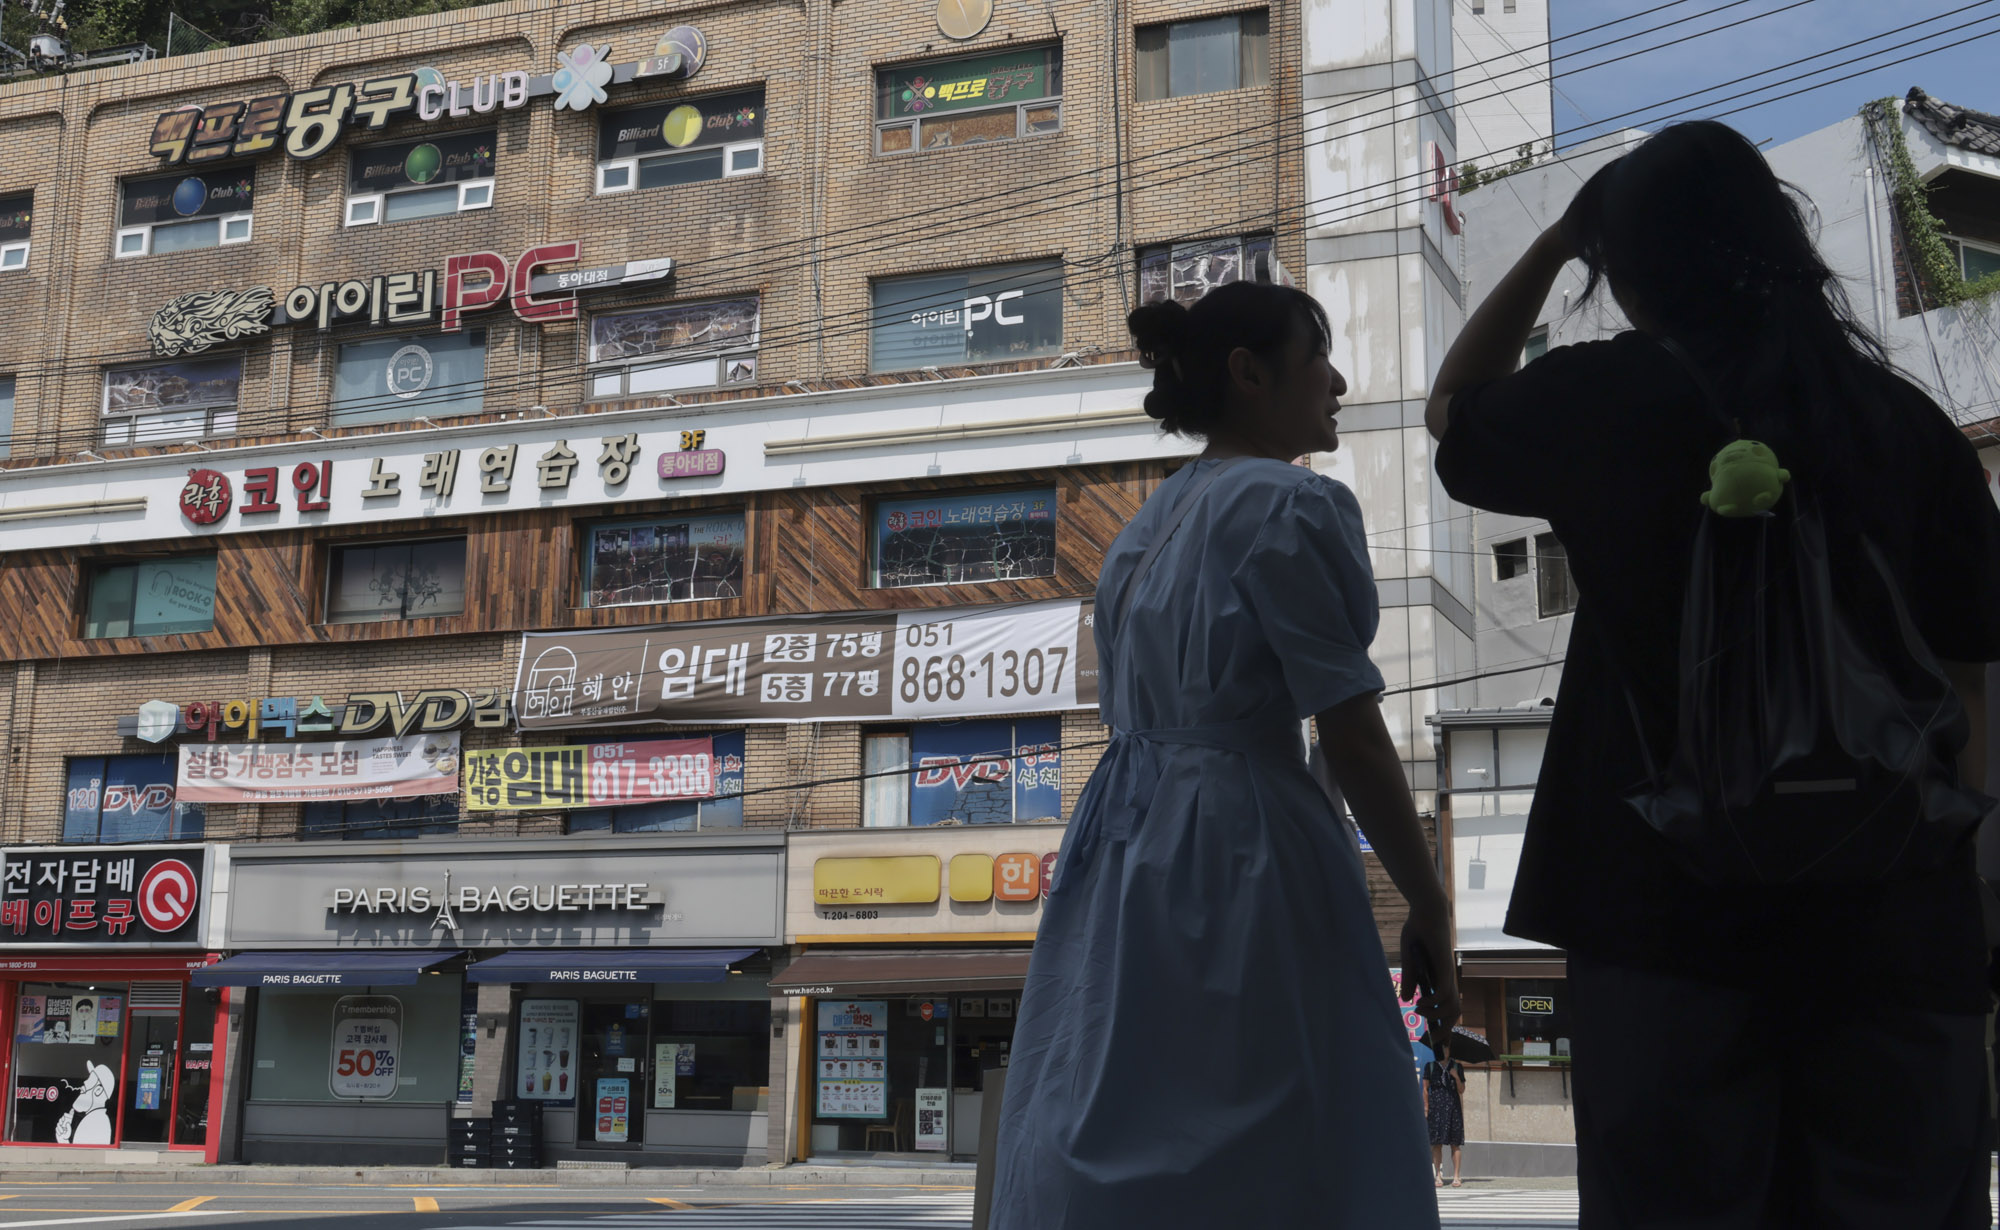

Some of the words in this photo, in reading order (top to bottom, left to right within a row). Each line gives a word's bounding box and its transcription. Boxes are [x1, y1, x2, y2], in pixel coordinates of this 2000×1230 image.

[618, 125, 659, 142] Billiard
[707, 114, 734, 129] Club
[363, 161, 402, 178] Billiard
[446, 151, 471, 165] Club
[210, 186, 234, 199] Club
[284, 268, 437, 332] 아이린
[441, 240, 582, 333] PC
[558, 269, 609, 288] 동아대점
[911, 309, 961, 328] 아이린
[964, 290, 1024, 331] PC
[397, 366, 422, 384] PC
[679, 430, 706, 450] 3F
[238, 459, 332, 514] 코인
[361, 432, 640, 499] 노래연습장
[660, 450, 720, 477] 동아대점
[909, 509, 943, 528] 코인
[944, 501, 1027, 525] 노래연습장
[1033, 501, 1046, 511] 3F
[770, 635, 810, 661] 2층
[826, 631, 883, 658] 75평
[906, 622, 953, 648] 051
[658, 641, 750, 700] 임대
[766, 675, 807, 702] 5층
[823, 669, 879, 697] 77평
[184, 695, 334, 741] 아이맥스
[372, 745, 404, 753] HAPPINESS
[393, 751, 411, 759] SWEET
[1018, 744, 1060, 767] 영화
[186, 751, 229, 779] 설빙
[236, 751, 314, 779] 가맹점주
[319, 750, 359, 776] 모집
[503, 749, 584, 806] 임대
[591, 752, 711, 802] 817-3388
[915, 754, 1012, 791] DVD
[1017, 767, 1060, 790] 산책
[103, 784, 175, 815] DVD
[4, 858, 135, 894] 전자담배
[333, 887, 430, 913] PARIS
[459, 883, 648, 913] BAGUETTE
[819, 887, 850, 899] 따끈한
[852, 886, 884, 898] 도시락
[0, 898, 136, 936] 베이프큐
[262, 975, 290, 984] PARIS
[293, 974, 342, 984] BAGUETTE
[550, 970, 579, 980] PARIS
[583, 970, 637, 980] BAGUETTE
[348, 1005, 396, 1015] membership
[1521, 1000, 1551, 1012] OPEN
[363, 1034, 388, 1044] 감사제
[185, 1060, 209, 1070] VAPE
[374, 1067, 394, 1077] OFF
[15, 1086, 46, 1099] VAPE
